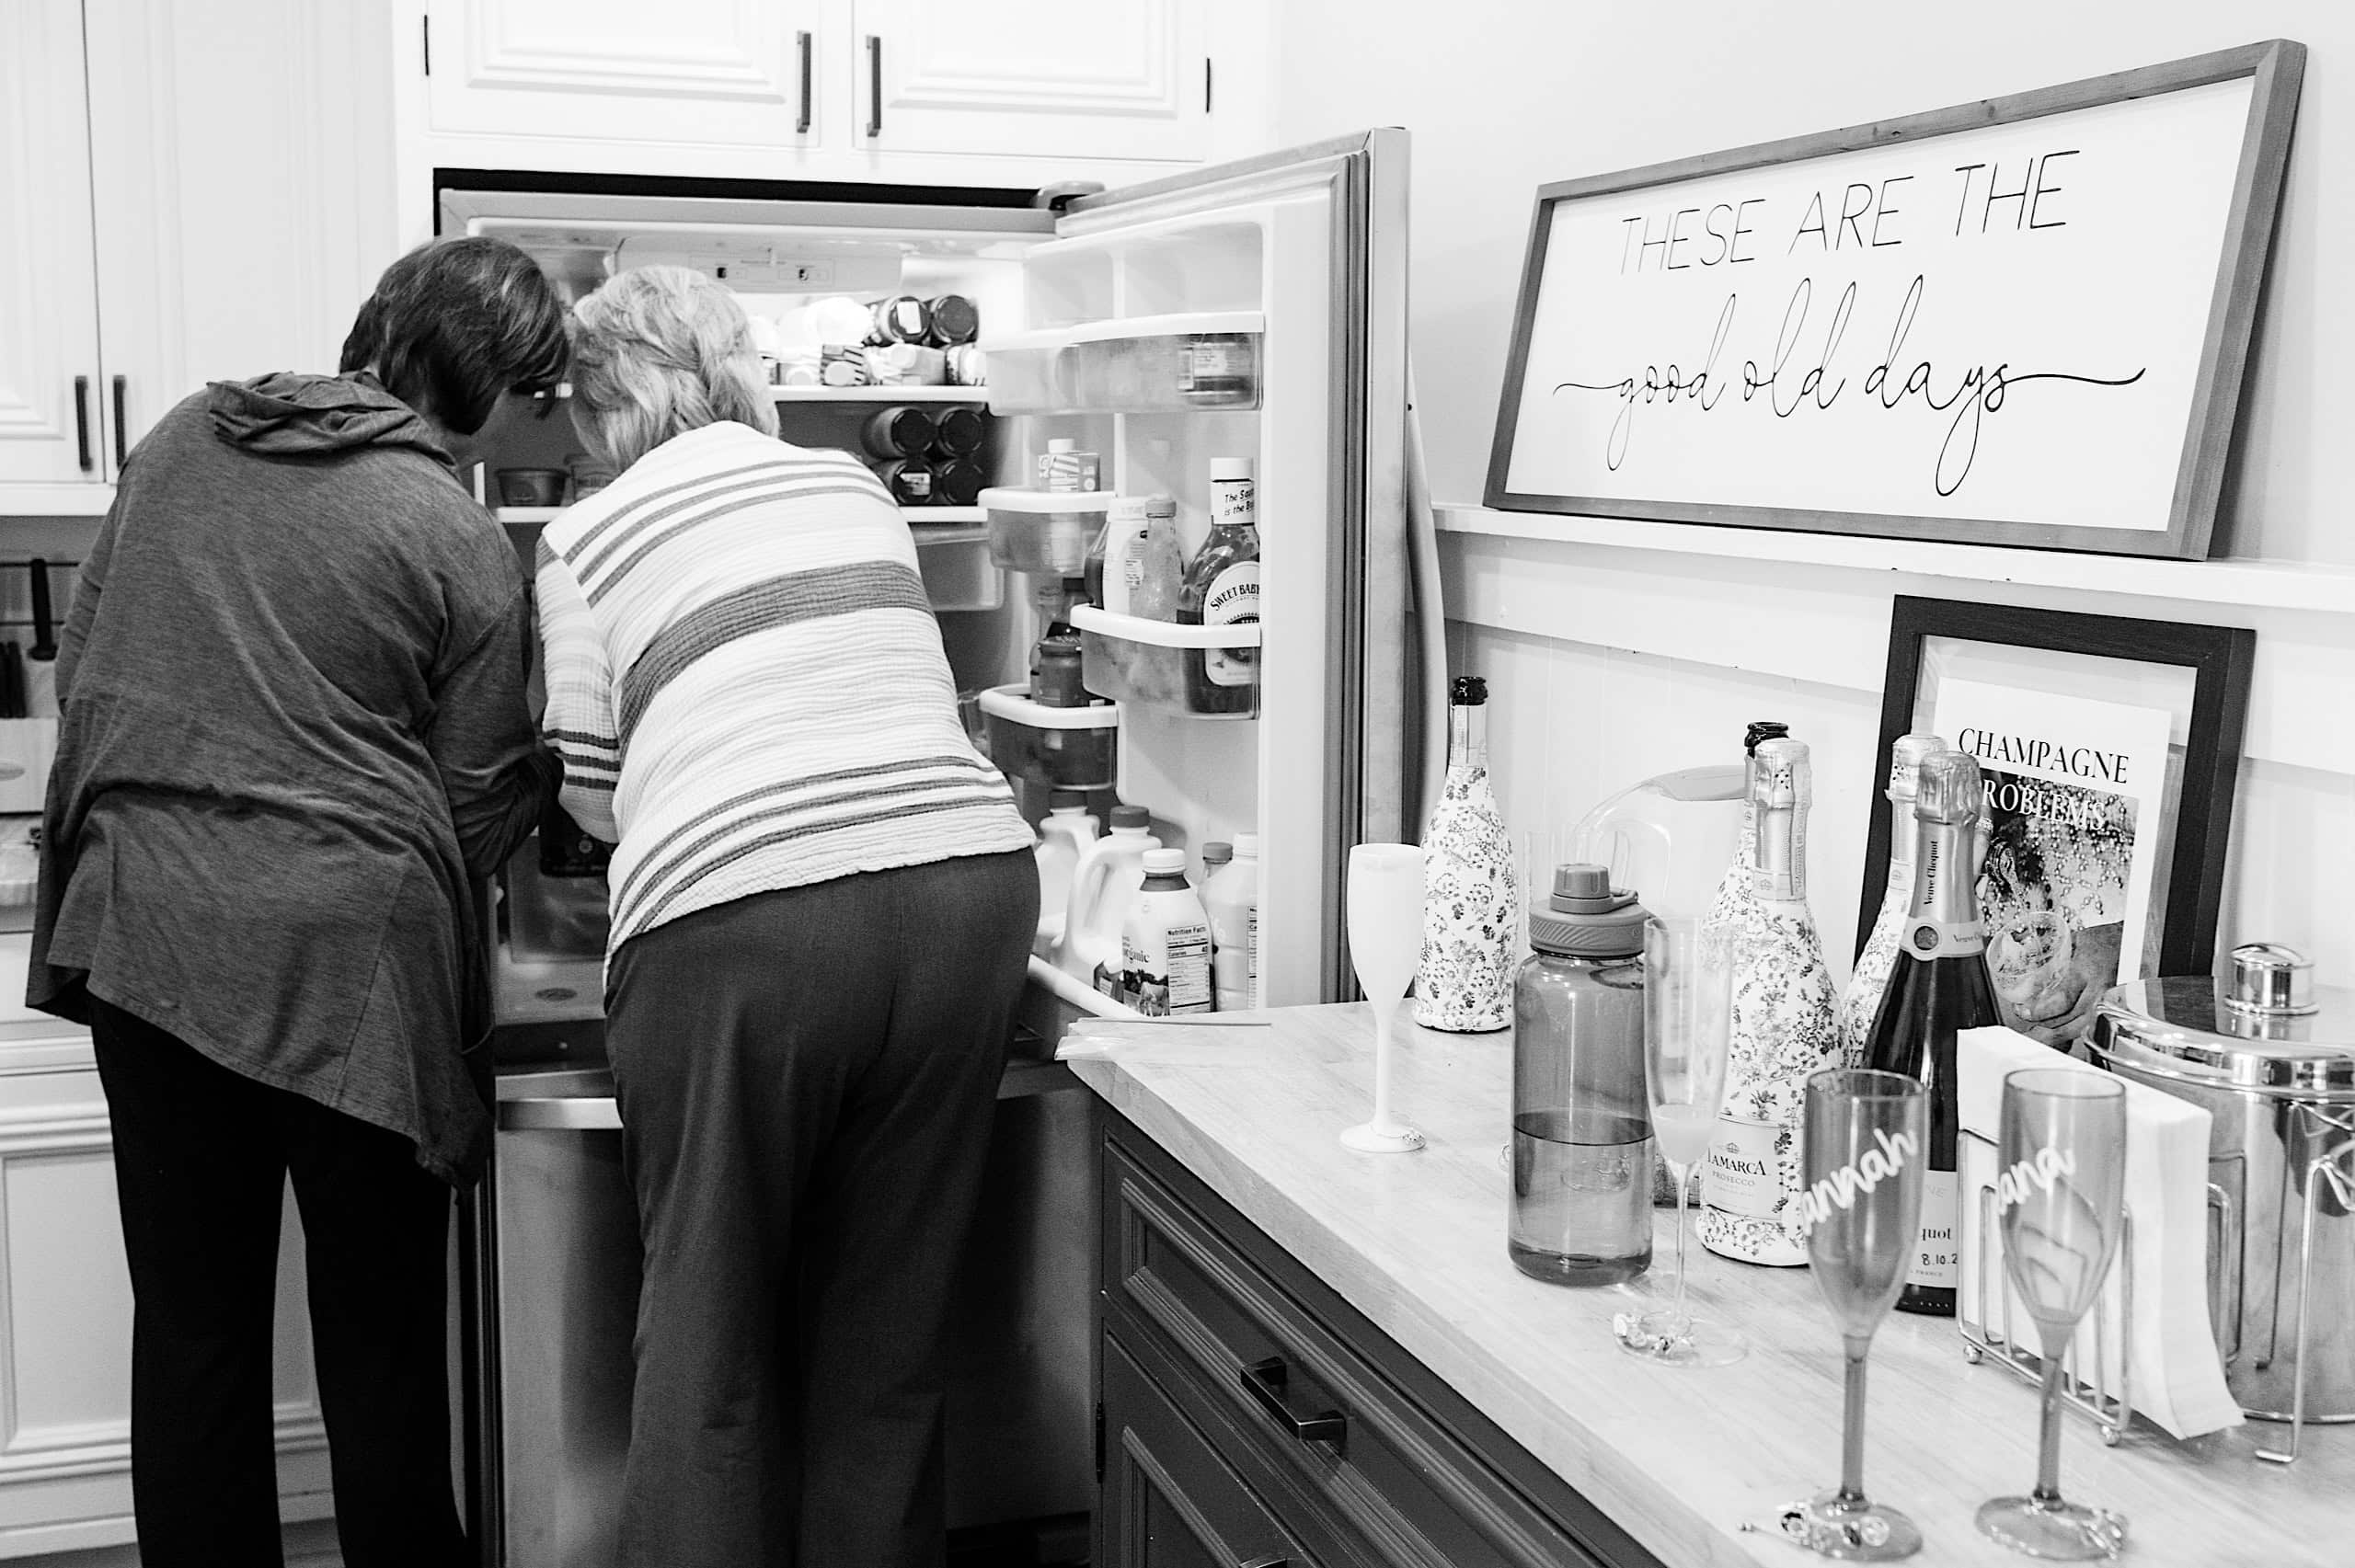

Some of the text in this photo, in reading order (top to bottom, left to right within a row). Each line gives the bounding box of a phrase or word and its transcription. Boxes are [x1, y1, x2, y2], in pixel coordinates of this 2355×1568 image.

[1621, 150, 2081, 275] THESE ARE THE
[1553, 274, 2146, 497] good old days
[1210, 587, 1237, 611] SWEET
[1959, 727, 2130, 784] CHAMPAGNE
[1982, 779, 2107, 831] ROBLEMS
[1923, 841, 1939, 905] Veuve Clicquot
